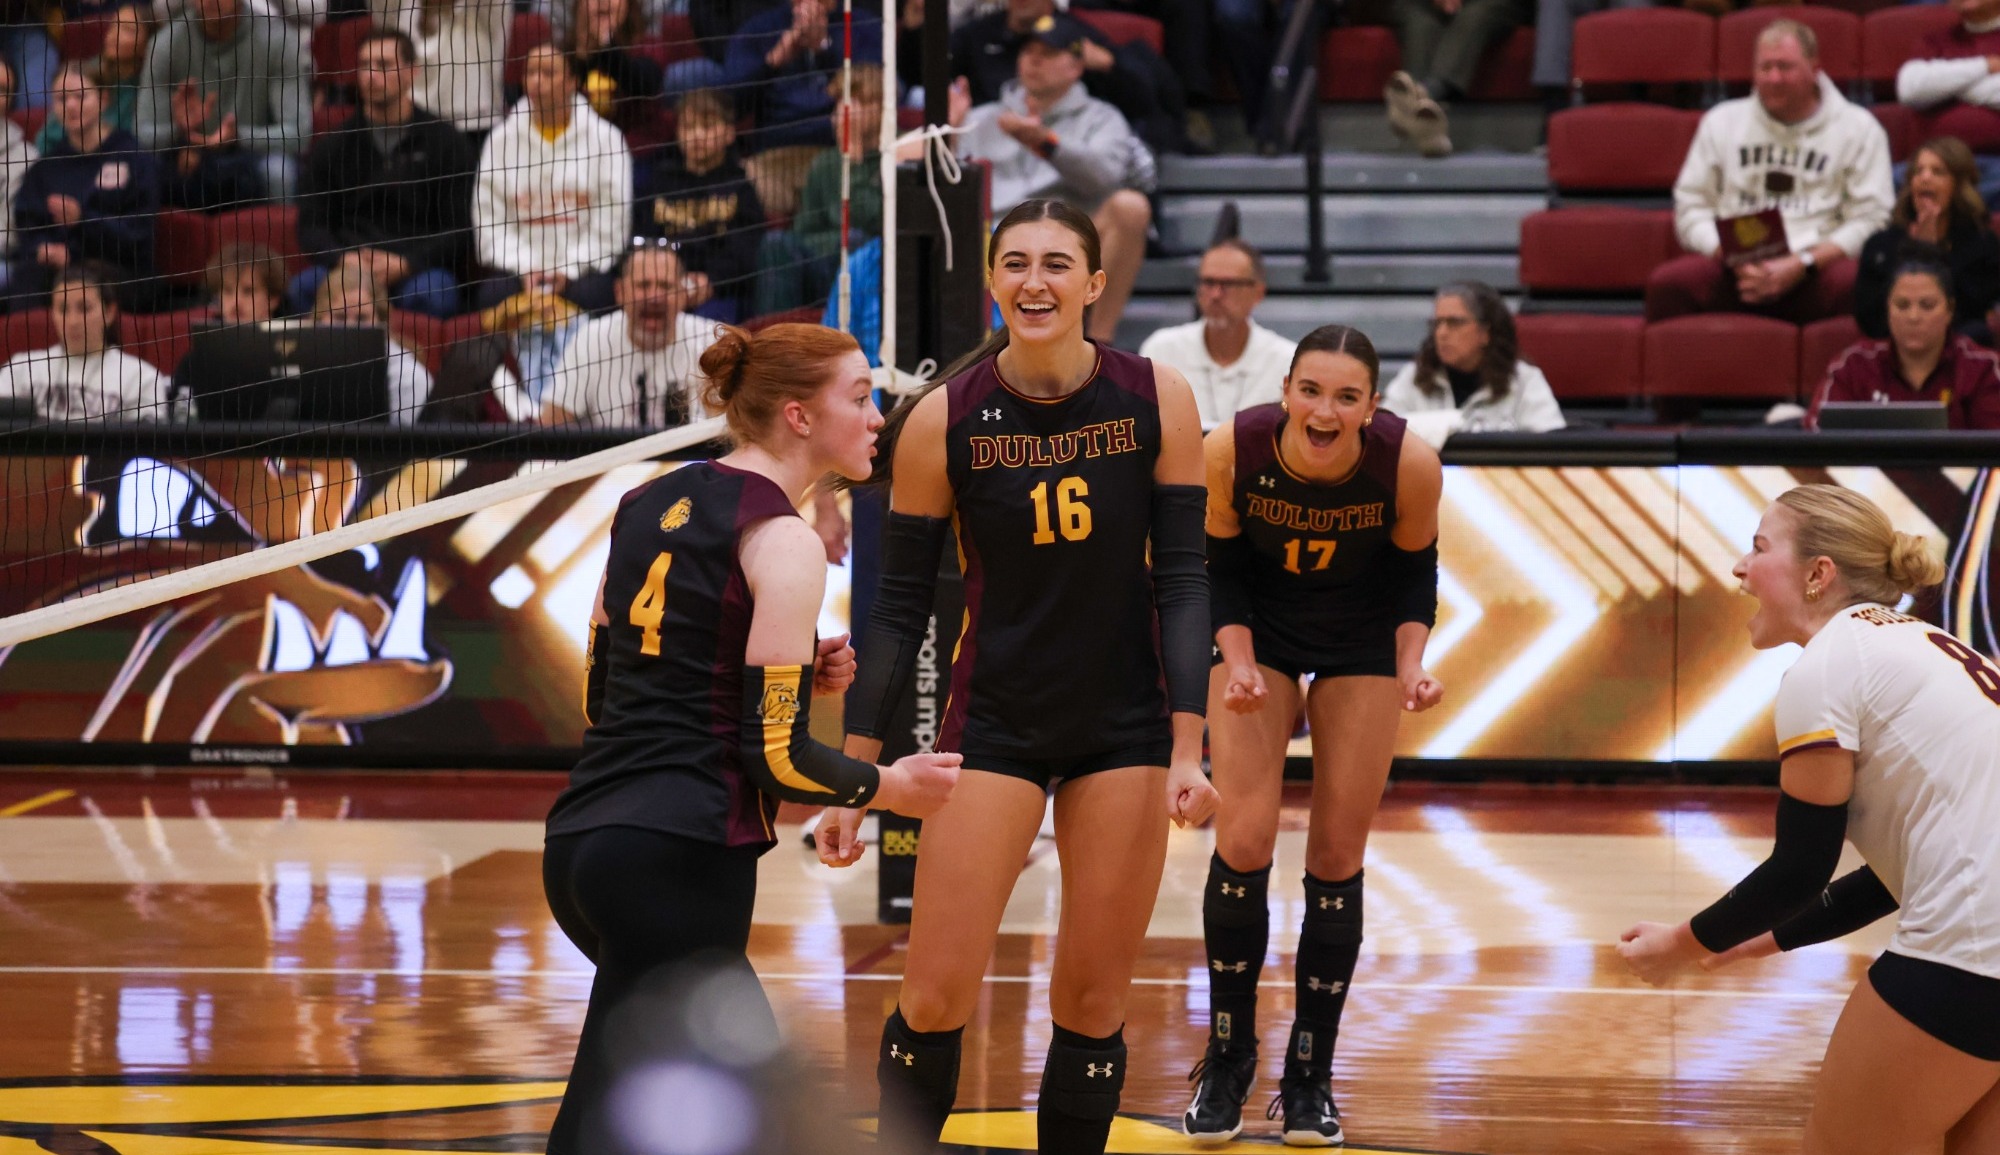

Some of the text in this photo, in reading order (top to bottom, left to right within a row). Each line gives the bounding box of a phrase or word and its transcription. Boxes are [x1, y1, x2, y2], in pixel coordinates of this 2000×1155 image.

[970, 419, 1136, 469] DULUTH
[1030, 476, 1092, 545] 16
[1247, 492, 1384, 532] DULUTH
[1283, 538, 1337, 575] 17
[630, 551, 672, 656] 4
[1924, 631, 2000, 708] 8
